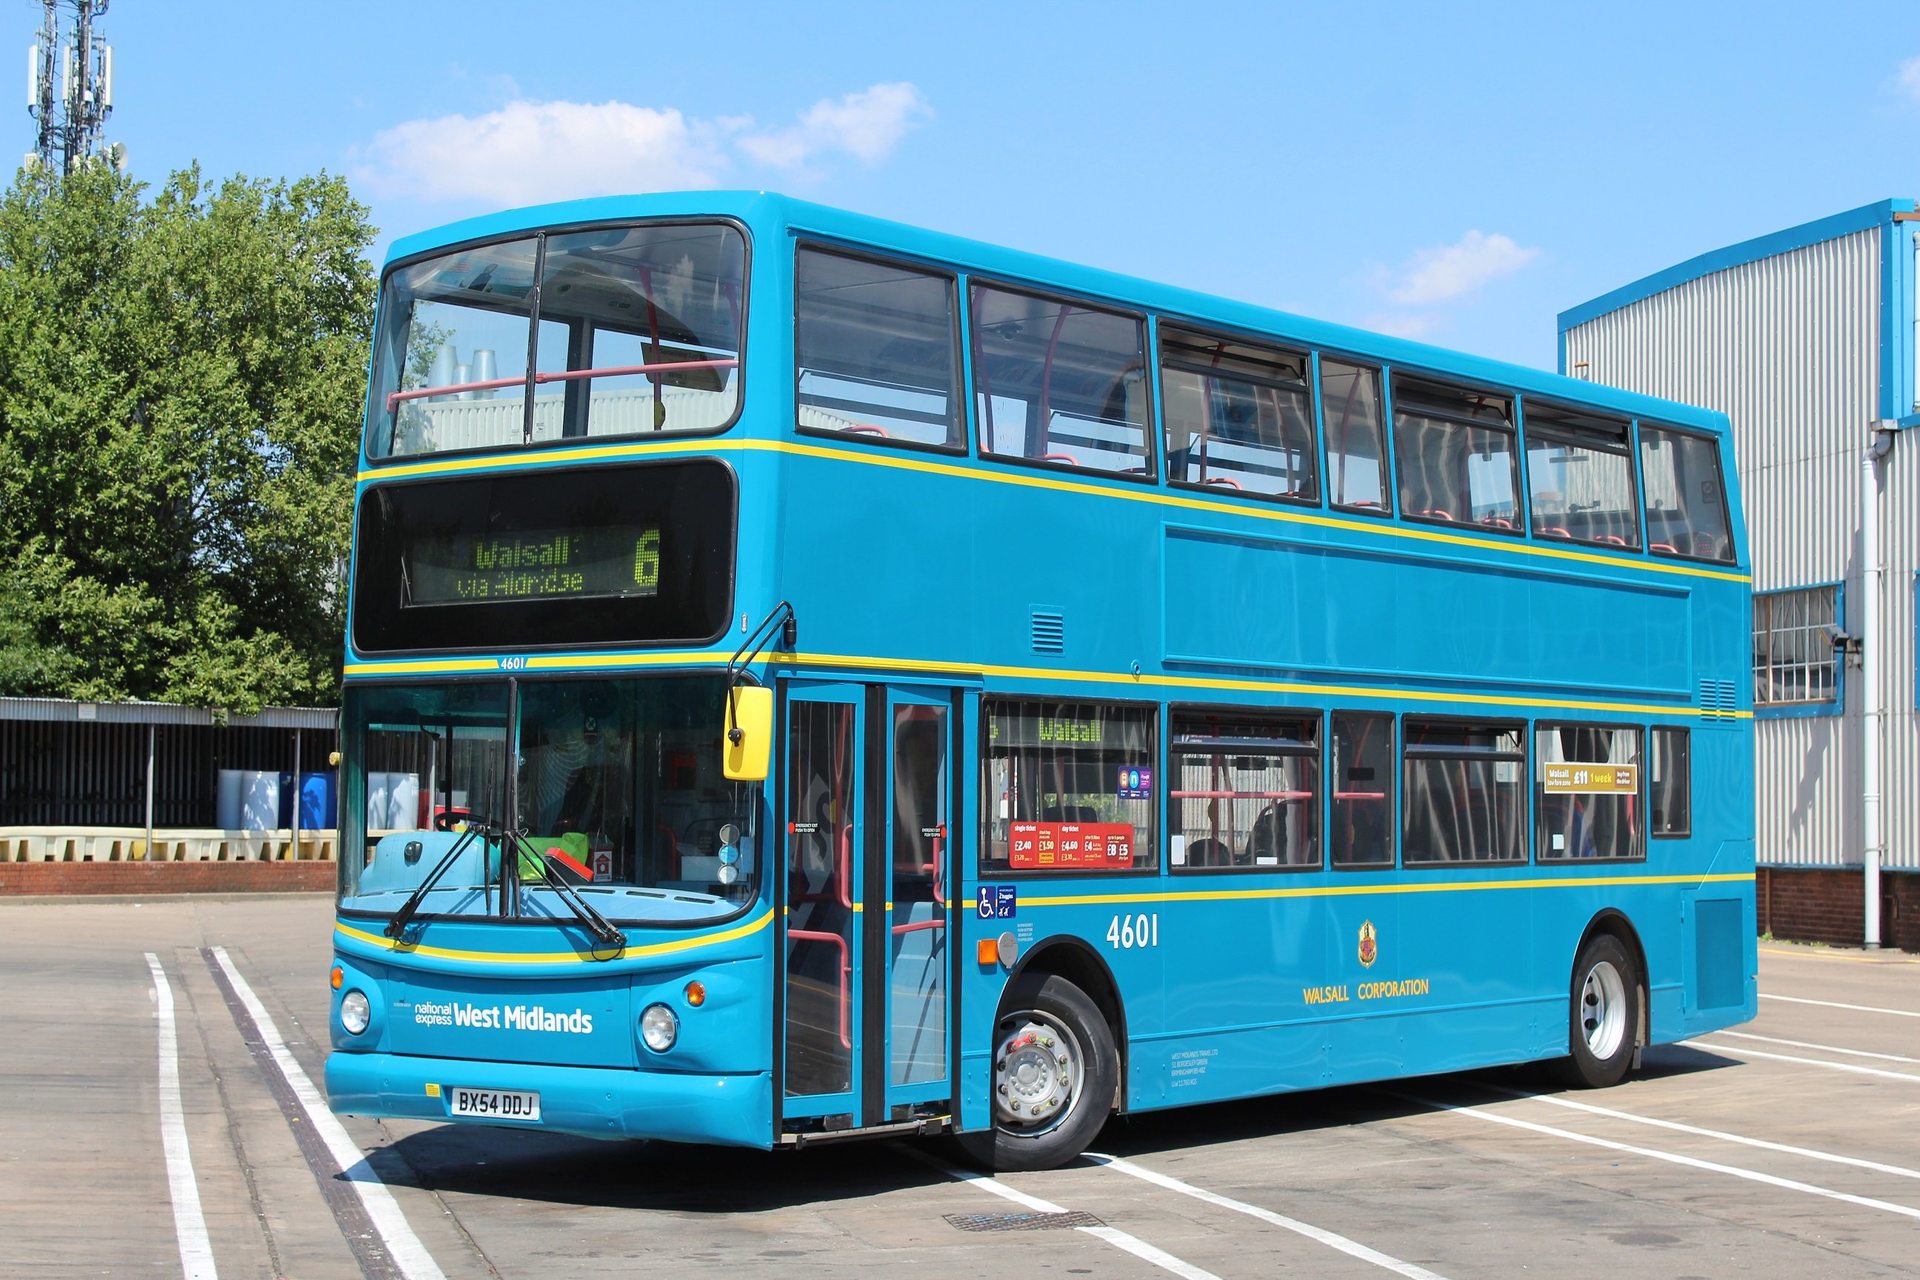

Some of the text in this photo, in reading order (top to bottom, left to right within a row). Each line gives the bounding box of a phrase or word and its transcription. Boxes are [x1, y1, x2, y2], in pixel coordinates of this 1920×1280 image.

[476, 535, 569, 569] Walsall
[634, 529, 660, 587] 6
[458, 572, 488, 597] via
[500, 657, 525, 670] 4601
[1039, 716, 1101, 742] Walsall
[1549, 769, 1570, 778] Walsall
[1574, 770, 1588, 785] £11
[1590, 773, 1612, 783] 1 week
[1014, 841, 1032, 851] £2.40
[1039, 841, 1054, 851] £1.50
[1084, 841, 1092, 851] £4
[1107, 844, 1116, 856] £8
[1119, 843, 1128, 856] £5
[1106, 913, 1158, 949] 4601
[1303, 979, 1429, 1005] WALSALL CORPORATION
[415, 1001, 451, 1015] national
[415, 1014, 452, 1027] express
[453, 1002, 593, 1034] West Midlands
[459, 1092, 532, 1116] BX54 DDJ
